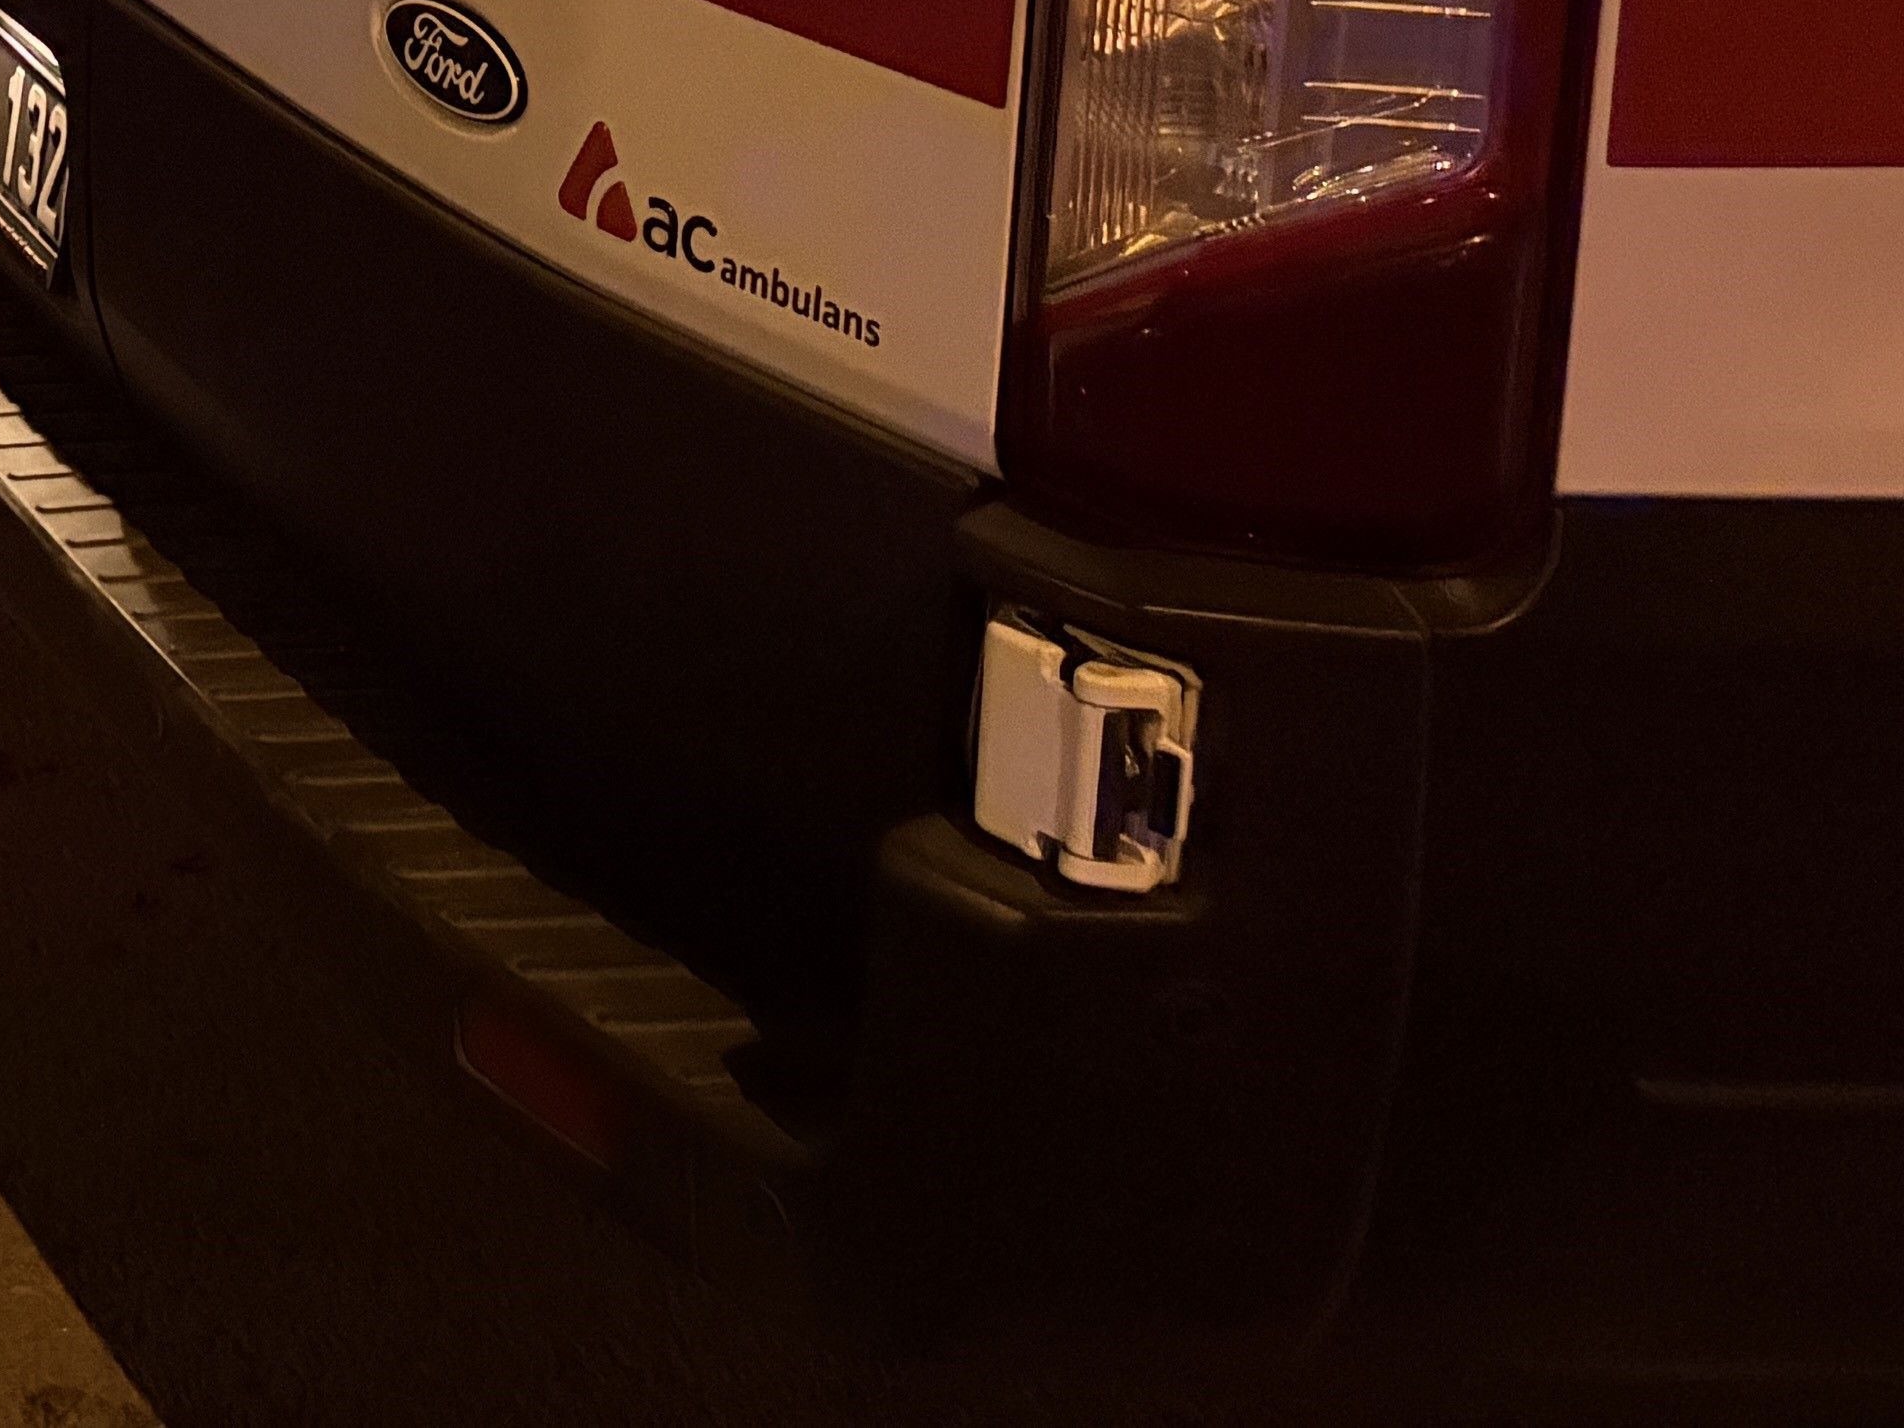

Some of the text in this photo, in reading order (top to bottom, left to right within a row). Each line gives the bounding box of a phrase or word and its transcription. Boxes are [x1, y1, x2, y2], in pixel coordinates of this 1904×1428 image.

[403, 11, 490, 106] Ford
[3, 64, 69, 242] 132
[720, 257, 881, 348] ambulans
